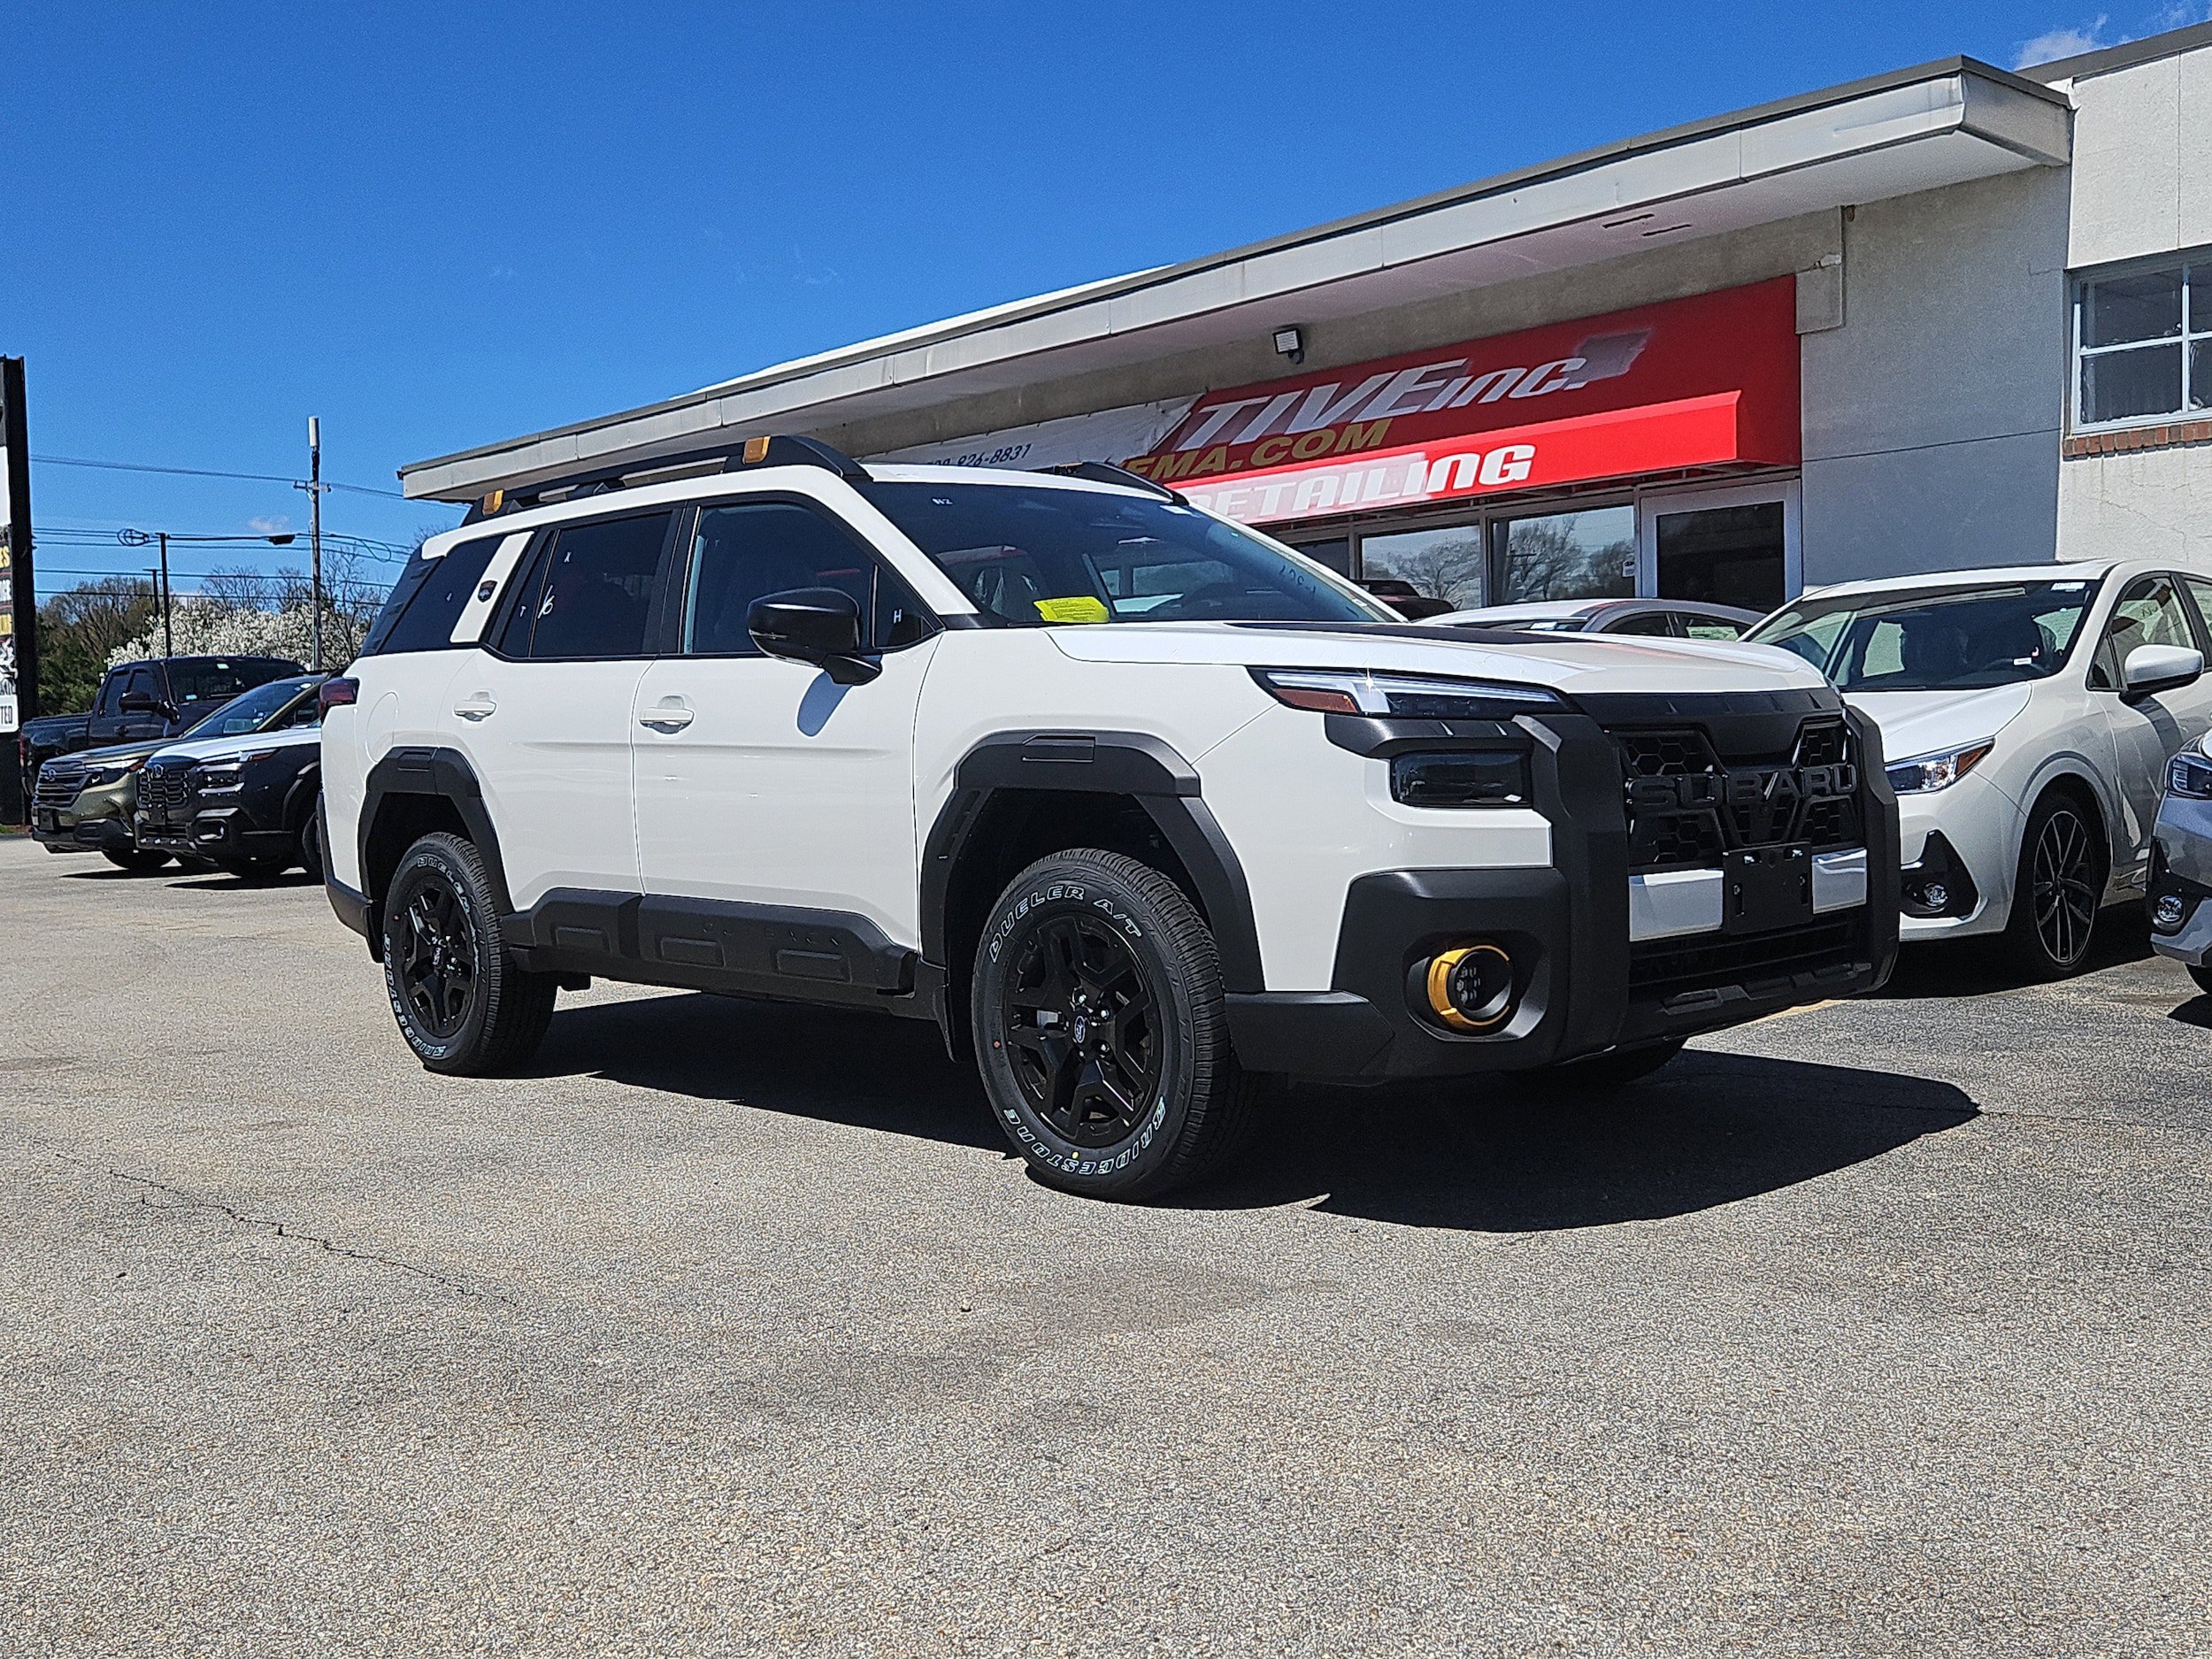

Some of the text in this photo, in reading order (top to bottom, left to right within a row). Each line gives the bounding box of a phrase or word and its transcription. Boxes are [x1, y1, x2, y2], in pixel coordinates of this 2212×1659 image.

[1176, 357, 1468, 452] TIVE
[1117, 417, 1393, 482] EMA.COM
[1627, 764, 1857, 809] SUBARU
[988, 886, 1086, 964] DUELER
[1003, 1096, 1166, 1175] BRIDGESTONE
